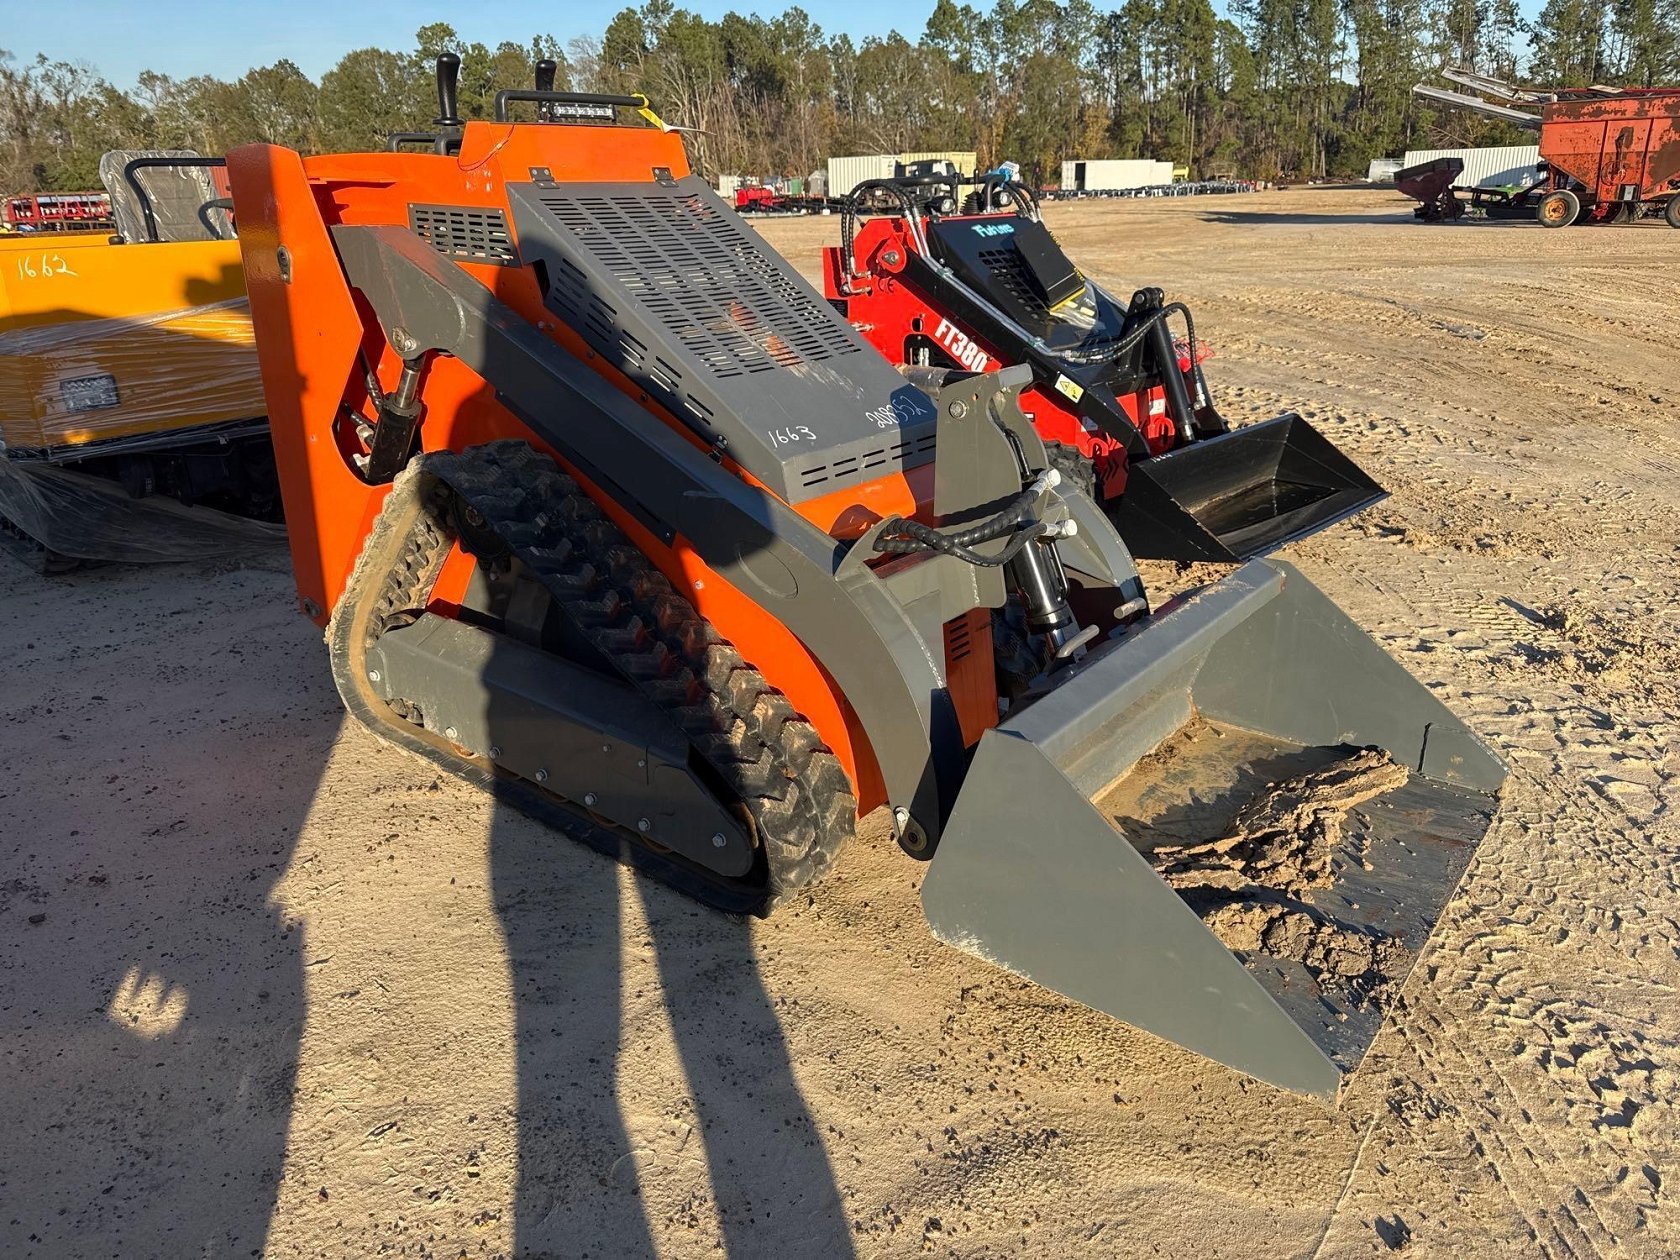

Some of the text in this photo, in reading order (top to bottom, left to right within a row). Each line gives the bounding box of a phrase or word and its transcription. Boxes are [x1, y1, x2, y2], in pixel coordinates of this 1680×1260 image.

[18, 254, 78, 280] 1662
[934, 318, 988, 372] FT380
[768, 425, 817, 448] 1663
